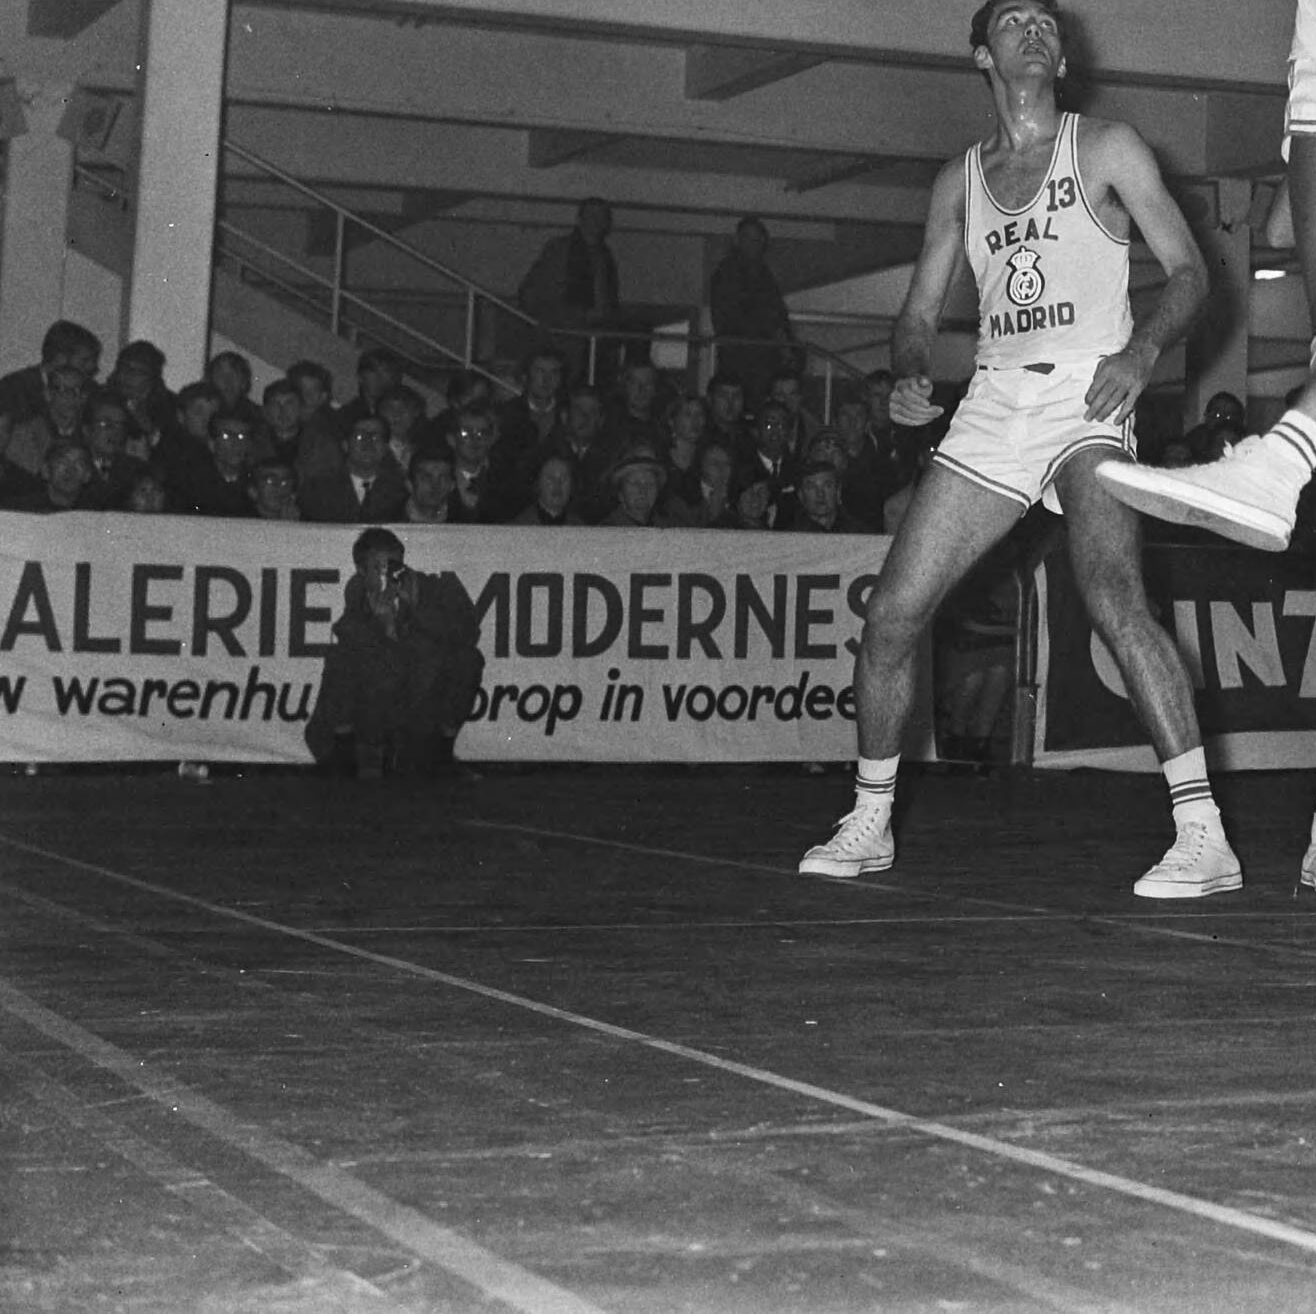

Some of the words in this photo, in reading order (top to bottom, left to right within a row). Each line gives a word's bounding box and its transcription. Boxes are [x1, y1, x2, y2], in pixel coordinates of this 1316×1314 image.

[1047, 176, 1076, 212] 13
[985, 216, 1059, 256] REAL
[989, 301, 1075, 339] MADRID
[600, 667, 644, 722] in
